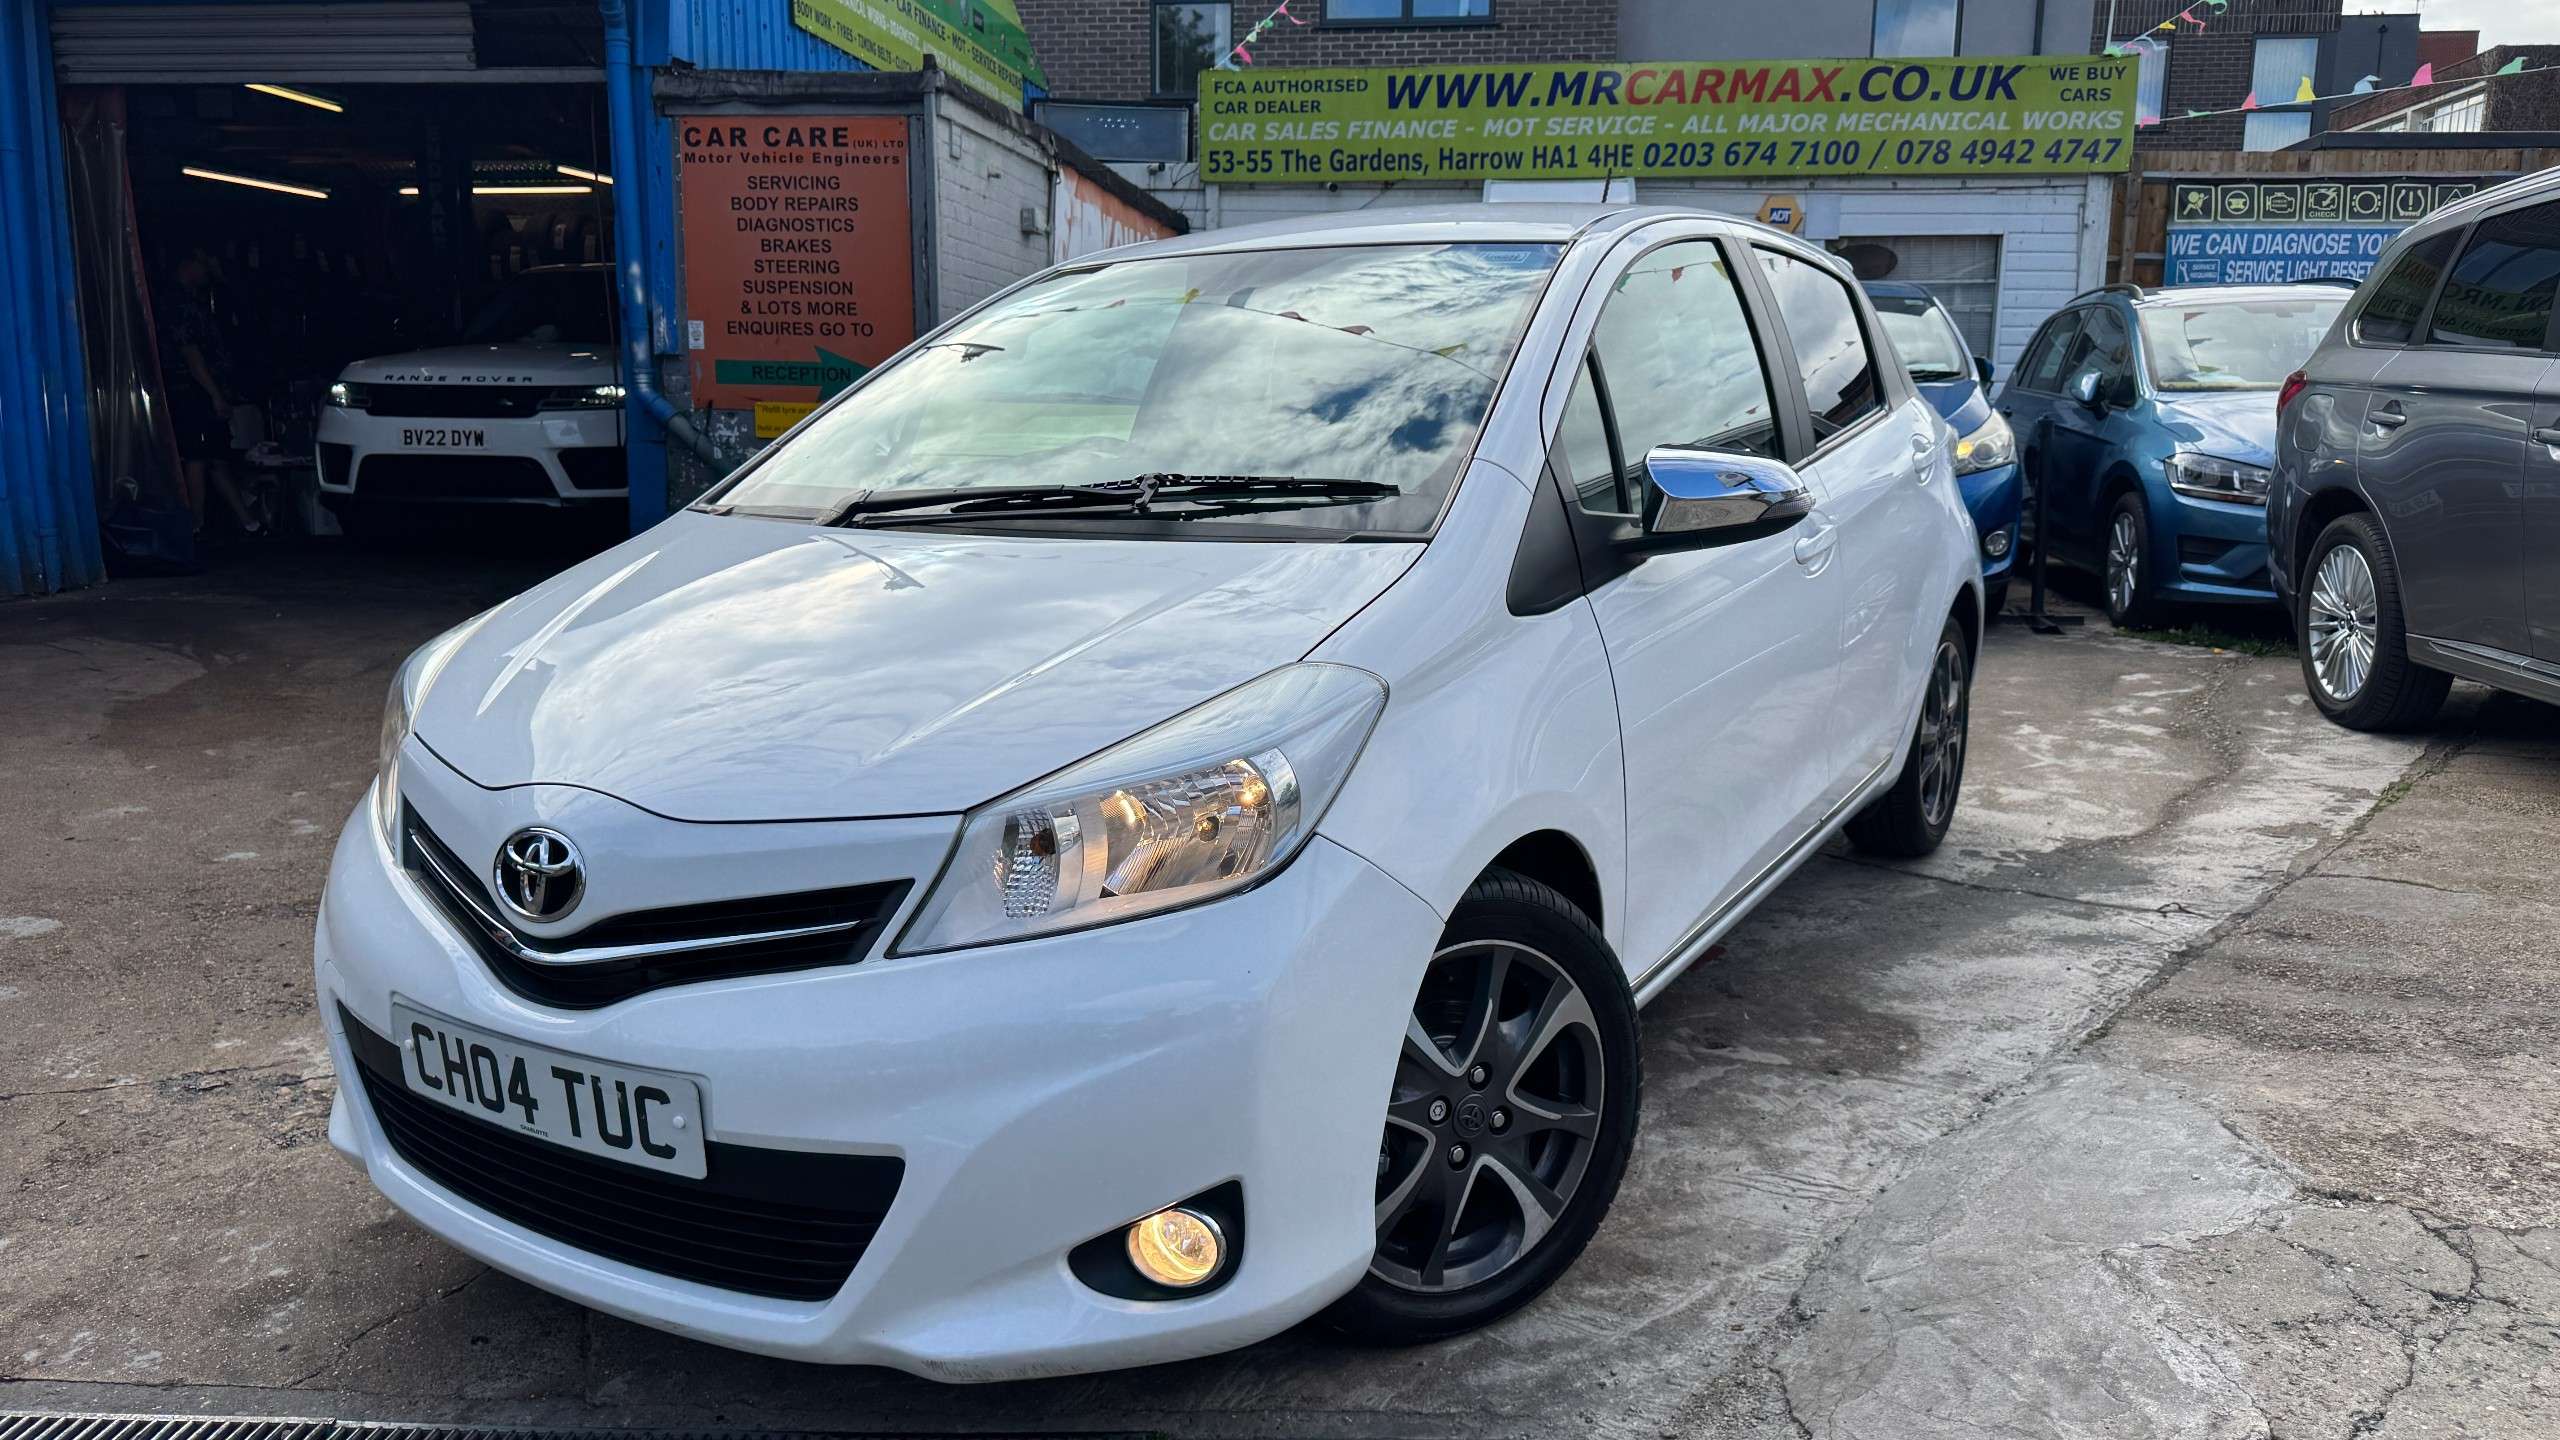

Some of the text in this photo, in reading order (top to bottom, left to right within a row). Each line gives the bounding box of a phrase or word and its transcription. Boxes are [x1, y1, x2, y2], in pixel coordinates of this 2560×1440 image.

[914, 6, 946, 41] FINANCE
[951, 31, 966, 54] MOT
[971, 45, 997, 74] SERVICE
[2050, 66, 2127, 81] WE BUY
[1214, 79, 1369, 94] FCA AUTHORISED
[1386, 64, 2026, 110] WWW.MRCARMAX.CO.UK
[2060, 88, 2112, 102] CARS
[1214, 100, 1322, 114] CAR DEALER
[1208, 122, 1257, 141] CAR
[1264, 121, 1341, 140] SALES
[1347, 119, 1458, 140] FINANCE
[1483, 117, 1540, 137] MOT
[1545, 115, 1657, 136] SERVICE
[1682, 114, 1728, 134] ALL
[1737, 112, 1828, 133] MAJOR
[1836, 111, 2010, 132] MECHANICAL
[2023, 110, 2124, 130] WORKS
[684, 126, 904, 149] CAR CARE (UK) LTD
[684, 152, 900, 167] Motor Vehicle Engineers
[1208, 138, 2122, 175] 53-55 The Gardens, Harrow HA1 4HE 0203 674 7100 / 078 4942 4747
[747, 175, 841, 190] SERVICING
[731, 196, 859, 211] BODY REPAIRS
[1769, 209, 1792, 222] ADT
[2309, 210, 2336, 218] CHECK
[737, 217, 855, 232] DIAGNOSTICS
[761, 238, 832, 253] BRAKES
[2171, 233, 2202, 256] WE
[2206, 233, 2249, 255] CAN
[2252, 233, 2351, 255] DIAGNOSE
[754, 259, 840, 274] STEERING
[2225, 260, 2283, 283] SERVICE
[2286, 261, 2326, 283] LIGHT
[743, 280, 853, 295] SUSPENSION
[741, 301, 857, 316] & LOTS MORE
[727, 320, 874, 337] ENQUIRES GO TO
[384, 374, 448, 382] RANGE
[752, 365, 850, 382] RECEPTION
[403, 429, 485, 447] BV22 DYW
[411, 1022, 677, 1160] CH04 TUC
